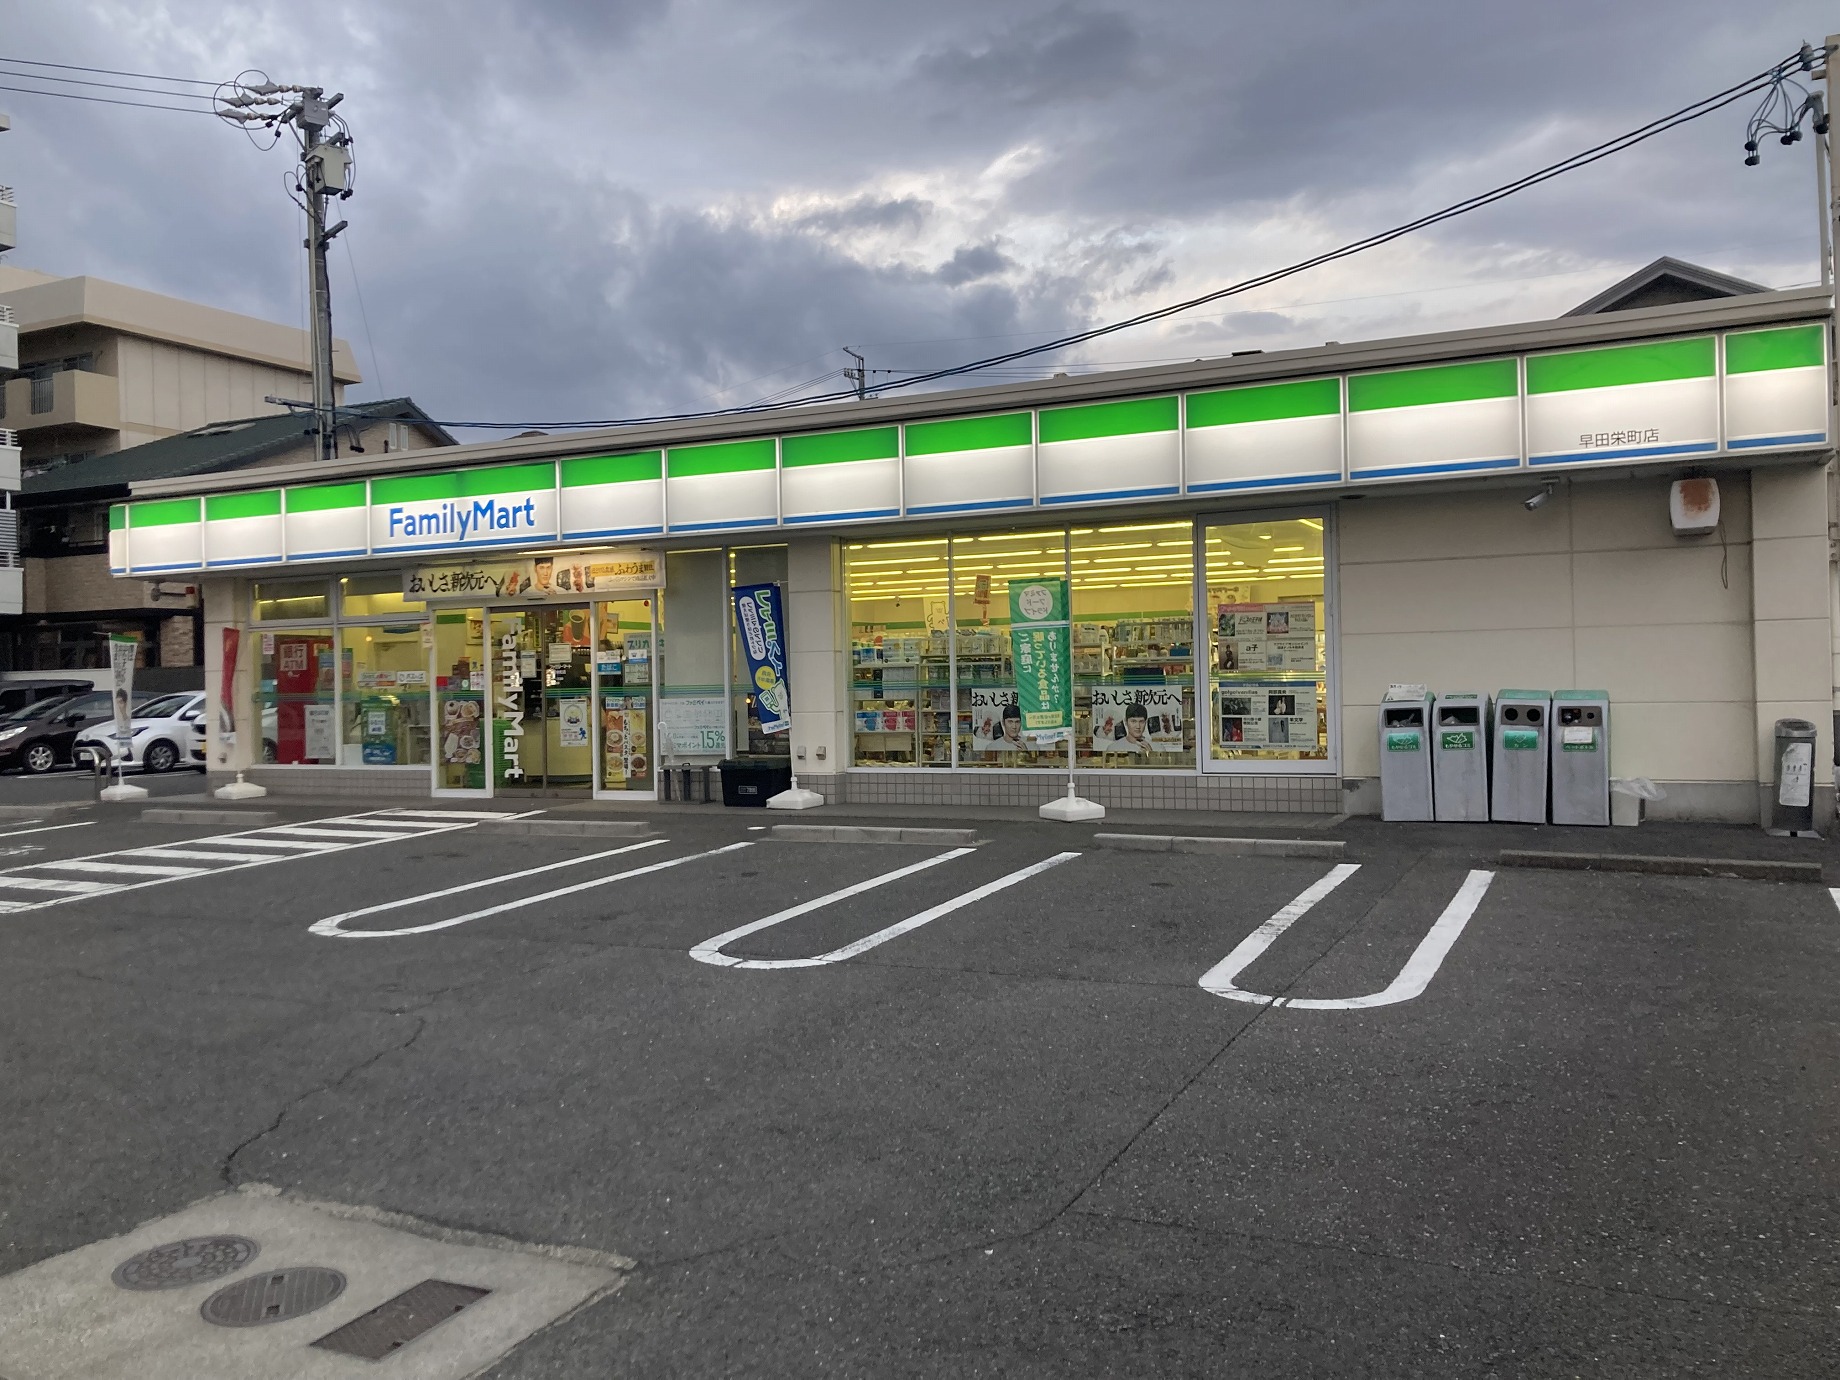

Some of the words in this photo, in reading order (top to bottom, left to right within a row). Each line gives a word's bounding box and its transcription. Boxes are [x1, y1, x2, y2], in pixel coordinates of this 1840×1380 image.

[1579, 428, 1660, 448] 早田栄町店
[389, 497, 535, 541] FamilyMart
[499, 617, 525, 779] FamilyMart
